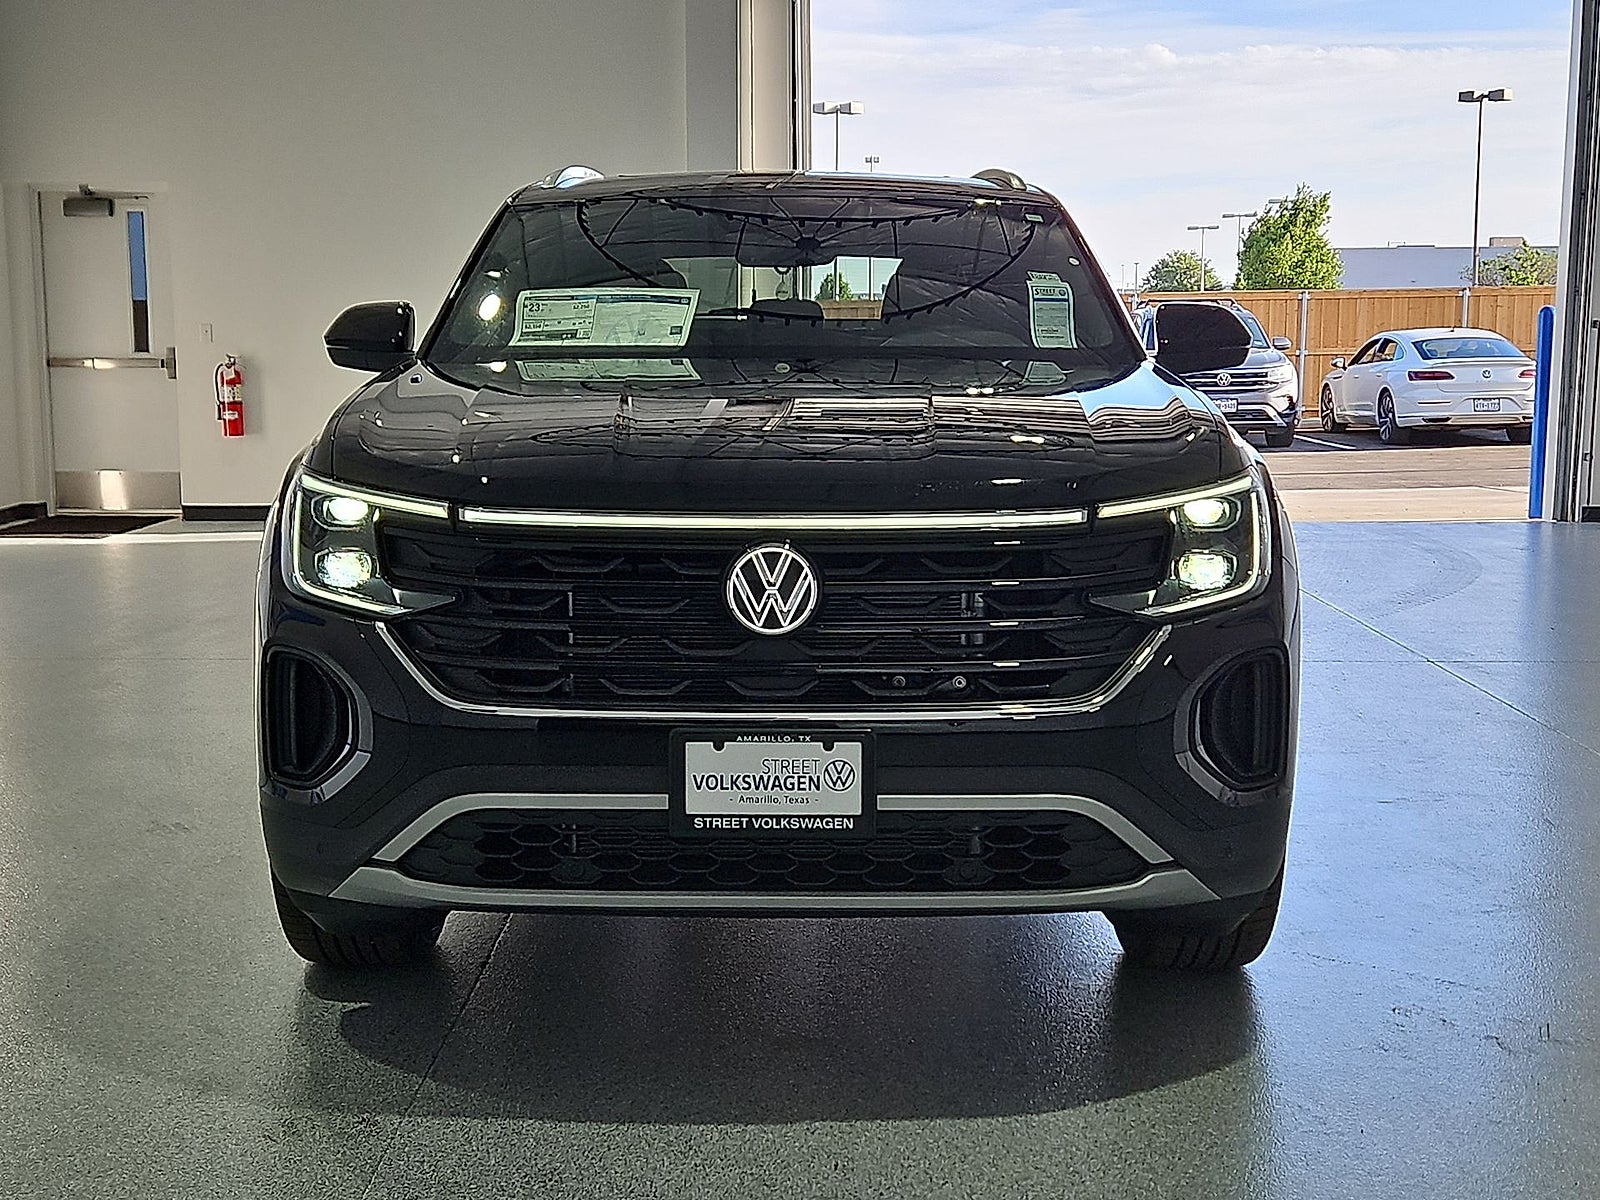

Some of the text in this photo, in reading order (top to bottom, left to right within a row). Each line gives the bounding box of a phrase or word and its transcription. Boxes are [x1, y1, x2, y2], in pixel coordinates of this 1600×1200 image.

[528, 302, 541, 312] 23
[1217, 372, 1231, 386] VW
[727, 544, 817, 635] VW
[761, 758, 821, 775] STREET
[692, 774, 821, 792] VOLKSWAGEN
[823, 759, 856, 792] VW
[738, 795, 810, 805] Amarillo, Texas
[693, 817, 854, 829] STREET VOLKSWAGEN
